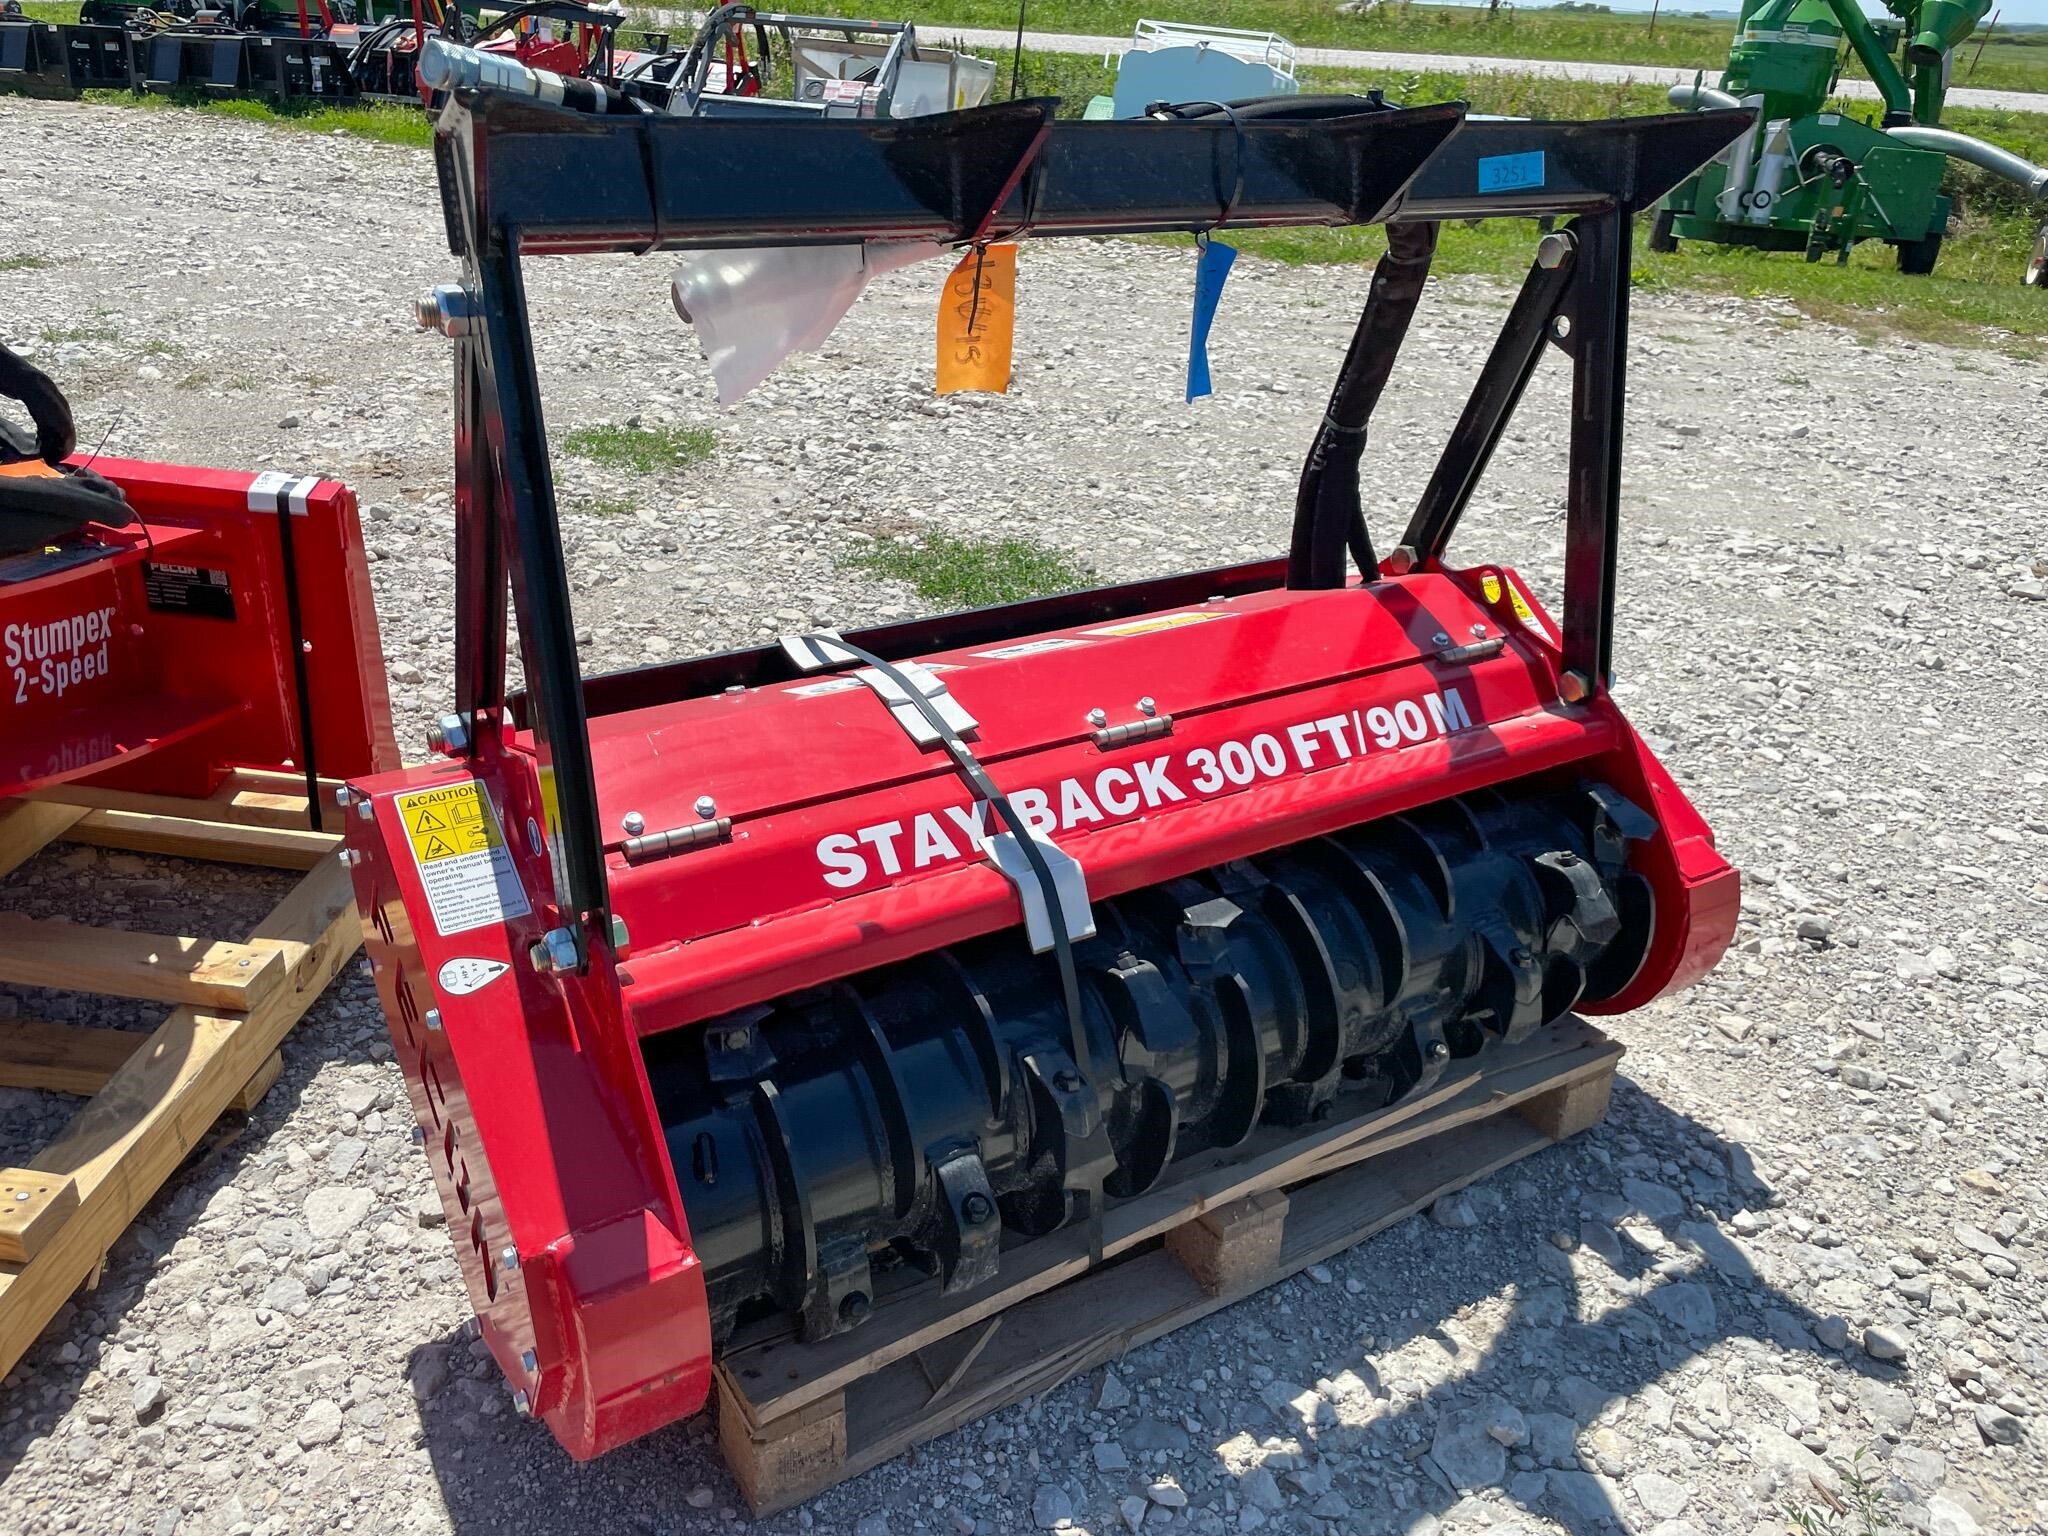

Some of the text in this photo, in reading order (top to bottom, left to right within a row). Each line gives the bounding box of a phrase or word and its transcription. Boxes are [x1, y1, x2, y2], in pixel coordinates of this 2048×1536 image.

[1492, 165, 1527, 185] 3251
[150, 562, 198, 576] FECON
[14, 641, 109, 704] 2-Speed
[417, 785, 479, 805] CAUTION
[816, 799, 989, 888] STAY
[1006, 755, 1188, 836] BACK
[1186, 733, 1287, 794] 300
[423, 848, 500, 871] Read and understand
[426, 855, 507, 878] owner's manual before
[430, 883, 453, 891] Periodic
[454, 875, 488, 886] maintenance
[449, 899, 469, 907] owner's
[471, 894, 490, 902] manual
[439, 905, 473, 917] maintenance
[441, 915, 460, 923] Failure
[468, 908, 488, 917] comply
[444, 919, 472, 930] equipment
